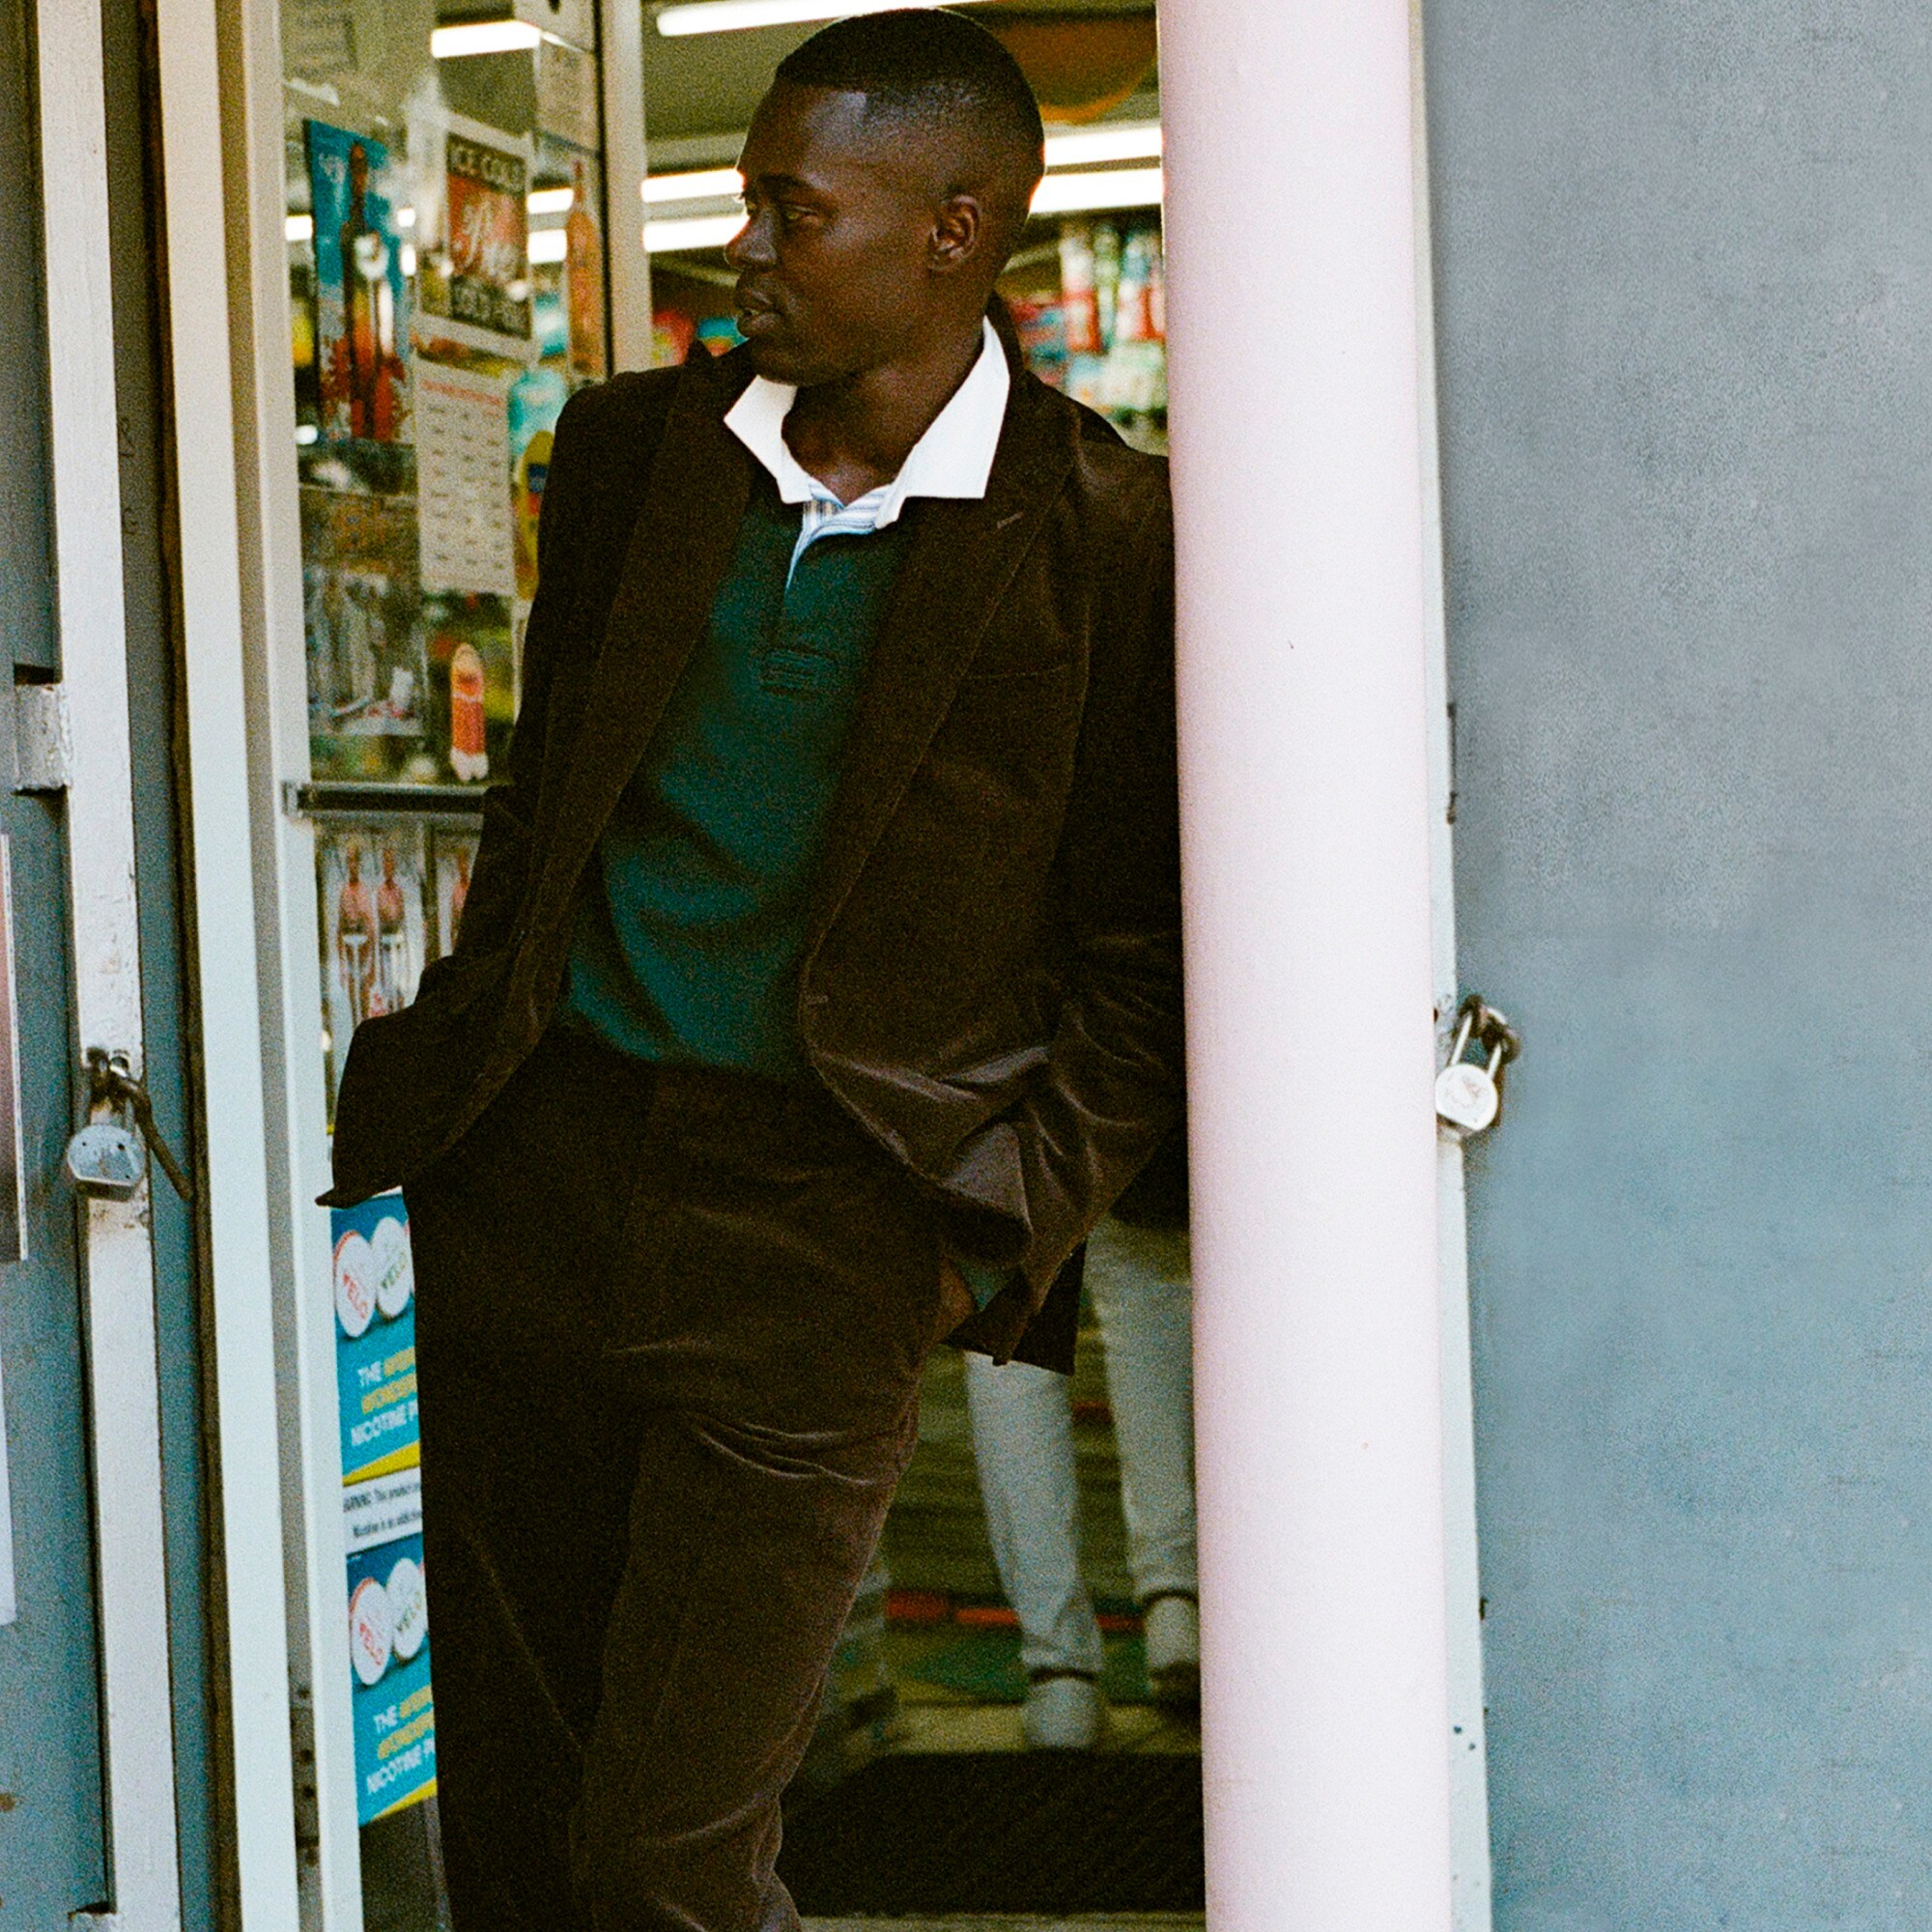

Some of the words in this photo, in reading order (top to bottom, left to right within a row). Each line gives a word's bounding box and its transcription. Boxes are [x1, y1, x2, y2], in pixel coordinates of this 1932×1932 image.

[343, 1272, 368, 1321] VELO
[357, 1360, 383, 1388] THE
[351, 1405, 407, 1446] NICOTINE
[373, 1704, 398, 1734] THE
[366, 1745, 422, 1795] NICOTINE
